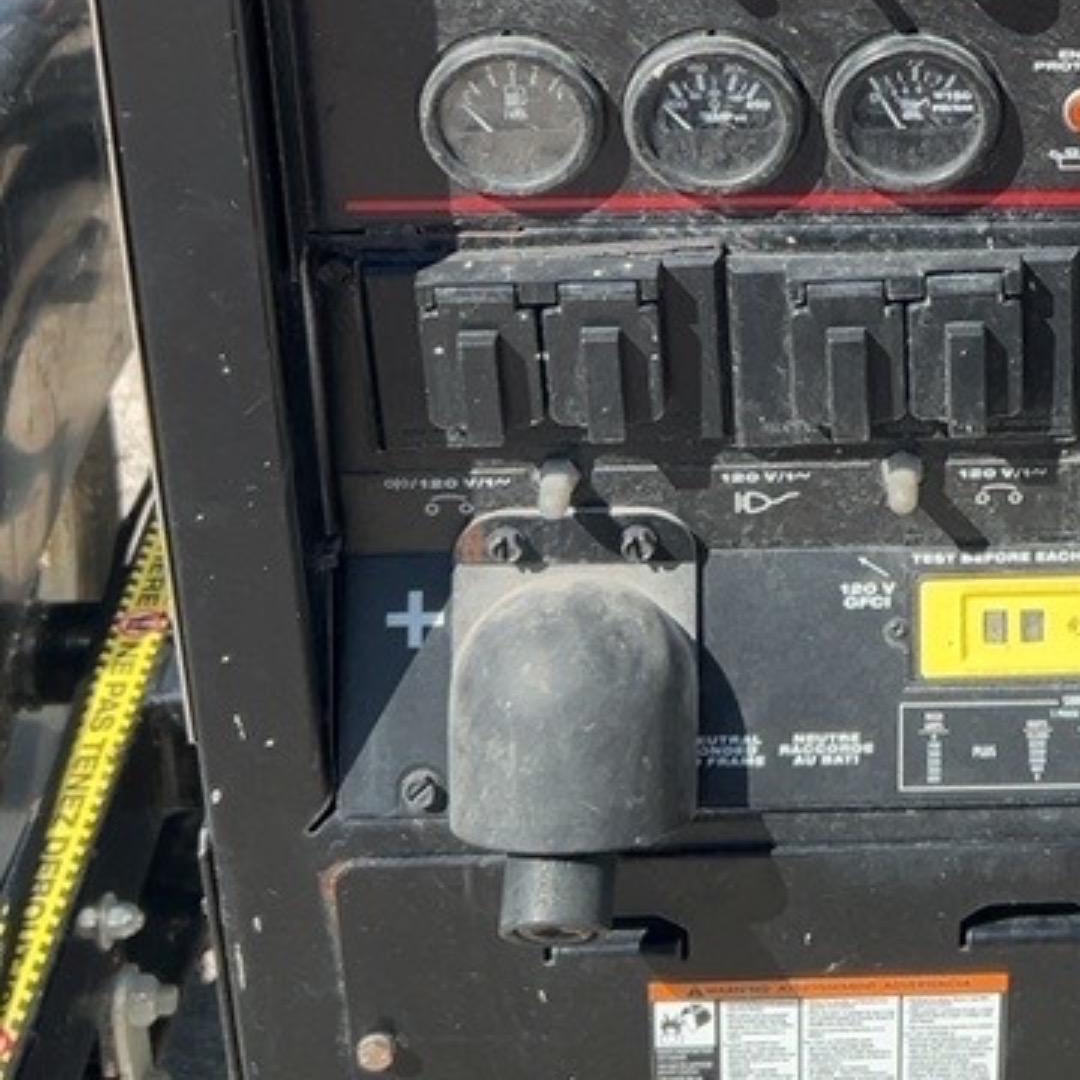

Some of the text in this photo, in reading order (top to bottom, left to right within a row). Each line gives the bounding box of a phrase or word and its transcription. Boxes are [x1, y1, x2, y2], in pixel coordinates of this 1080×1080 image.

[911, 553, 955, 565] TEST
[960, 552, 1030, 564] BEFORE
[881, 582, 896, 594] V
[843, 596, 892, 609] GFCI
[91, 681, 126, 733] PAS
